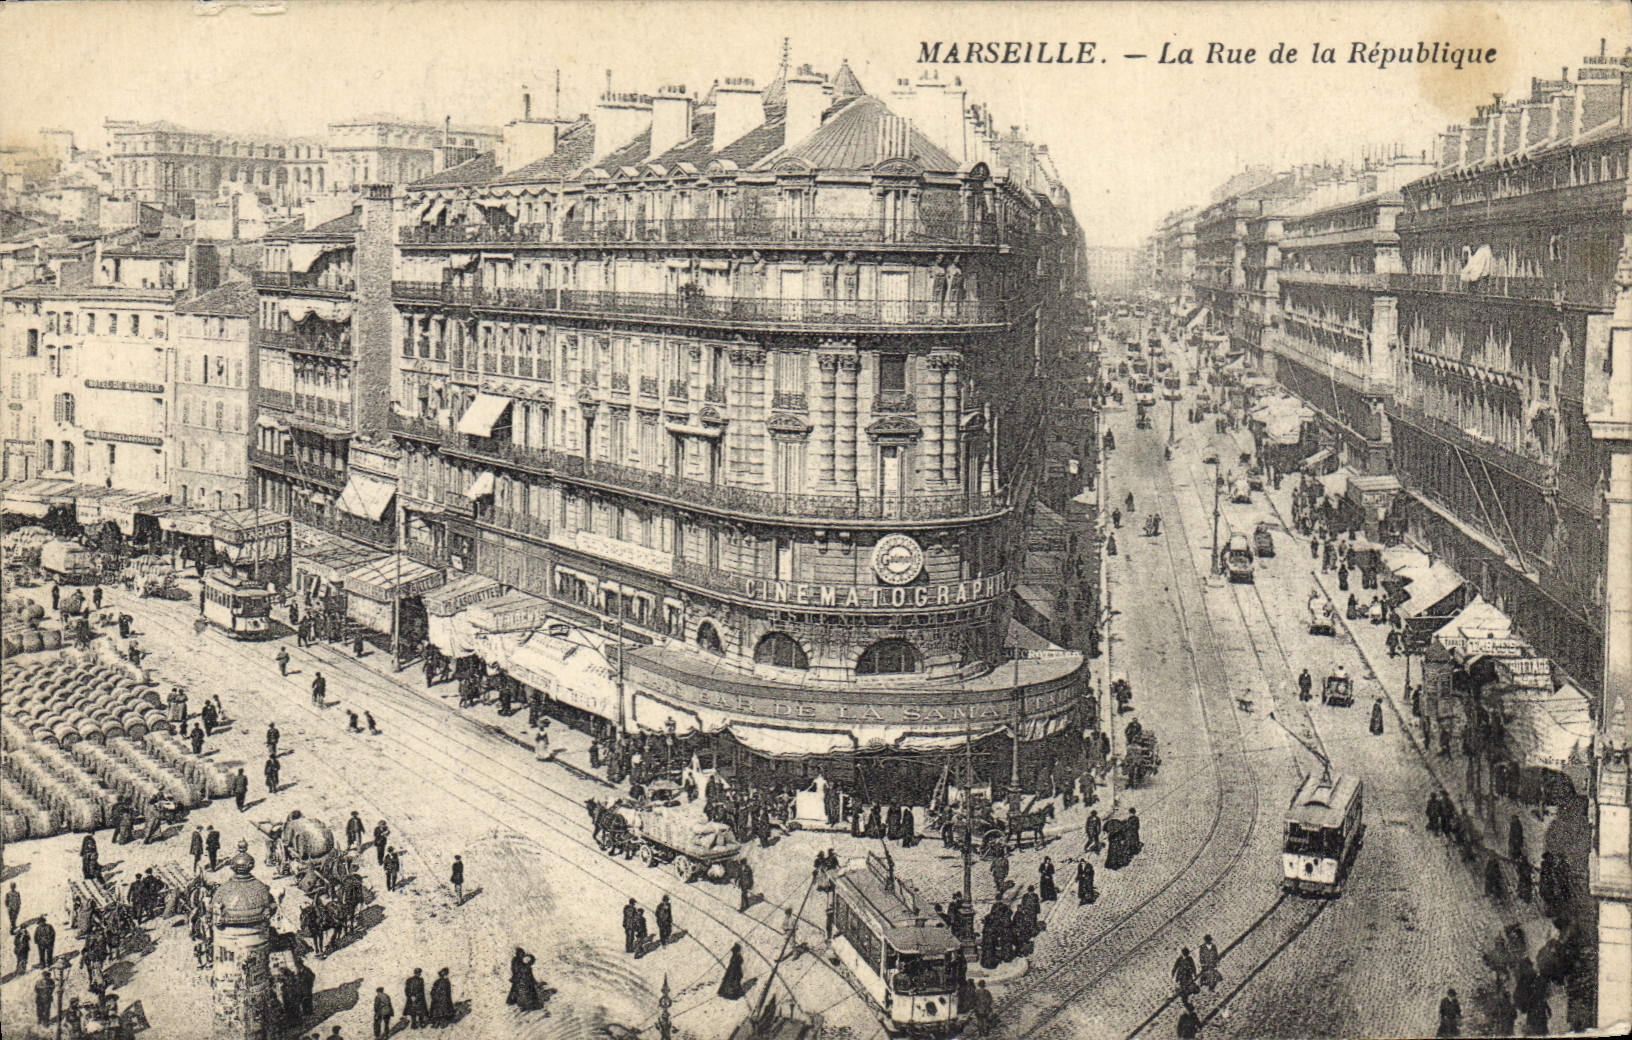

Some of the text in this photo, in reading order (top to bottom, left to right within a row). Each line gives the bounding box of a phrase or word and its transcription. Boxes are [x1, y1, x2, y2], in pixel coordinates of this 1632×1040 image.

[698, 689, 757, 714] BAR
[774, 703, 818, 719] DE
[838, 705, 884, 721] LA
